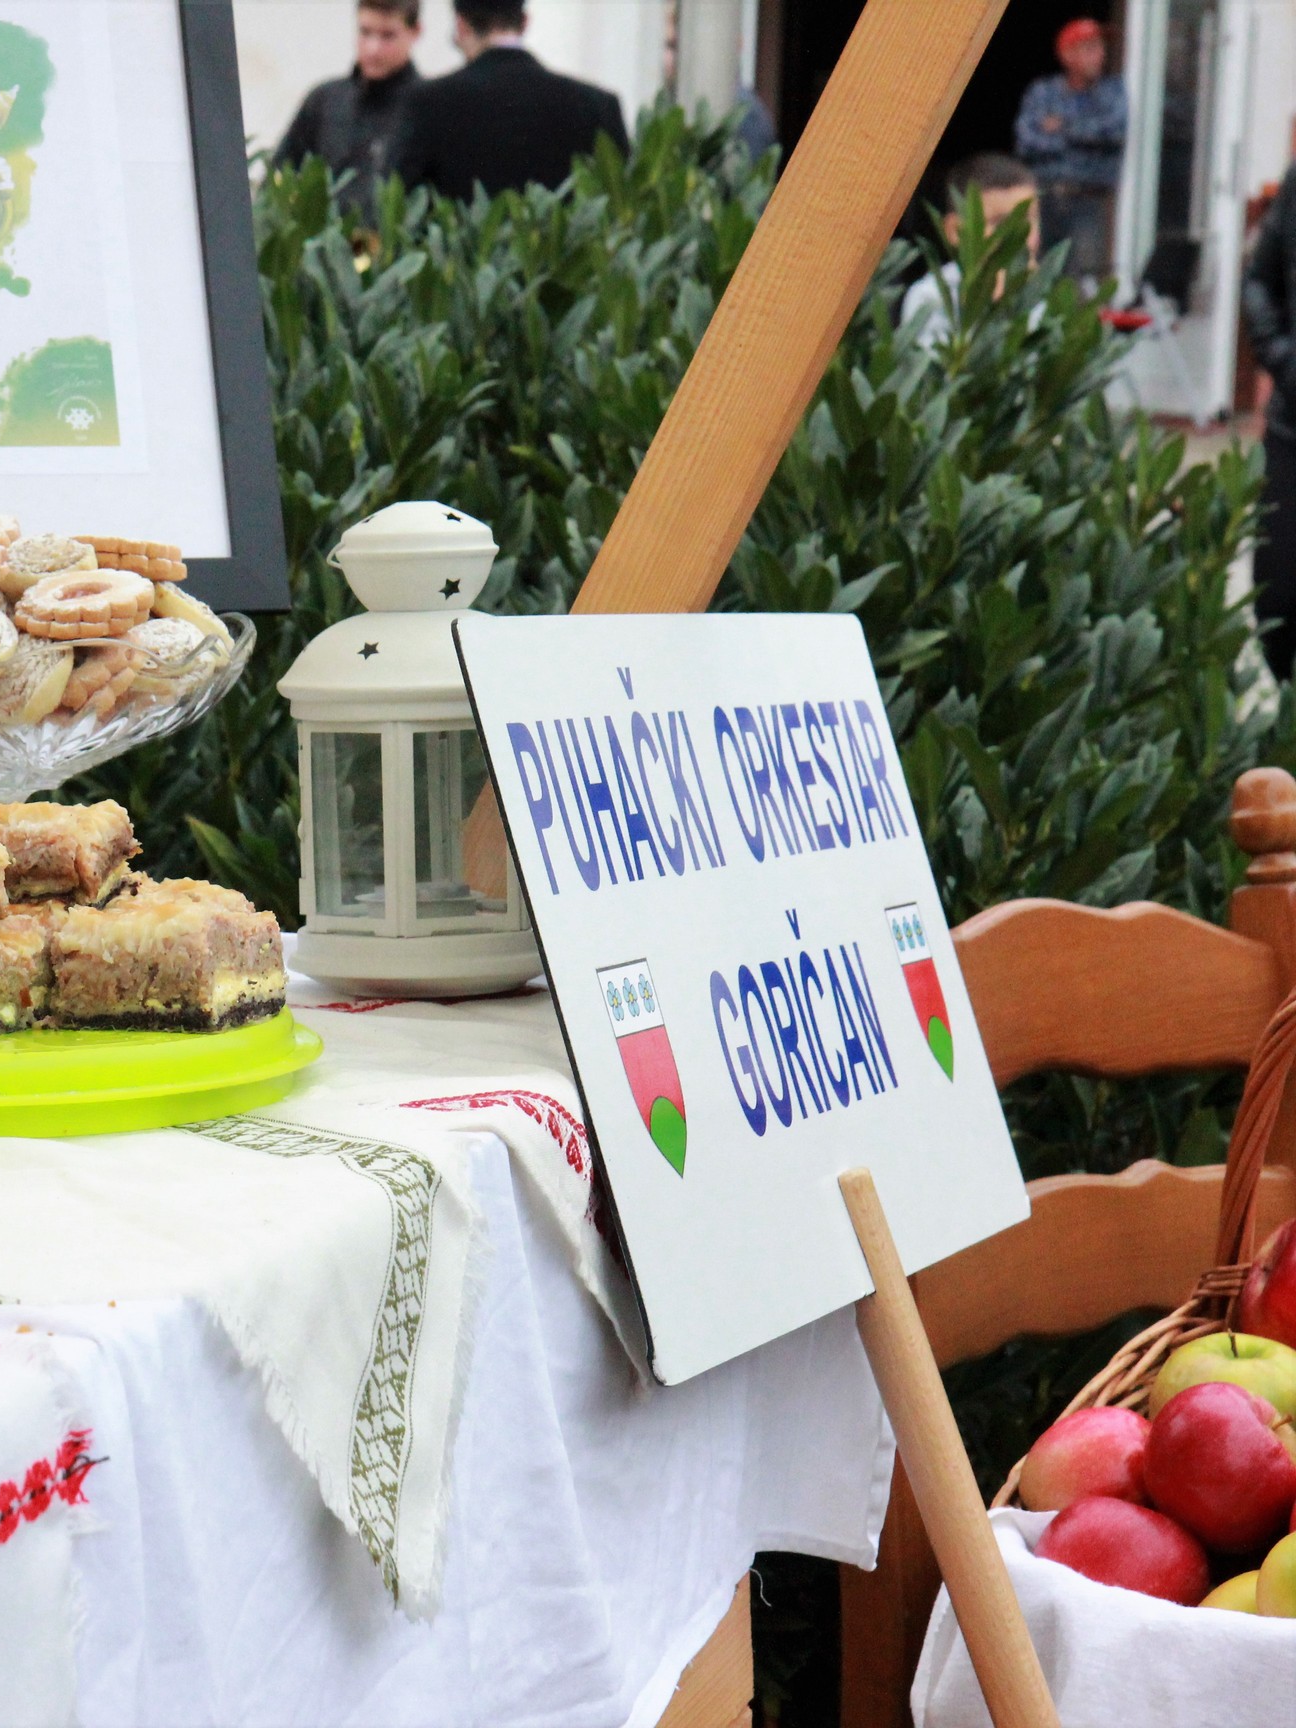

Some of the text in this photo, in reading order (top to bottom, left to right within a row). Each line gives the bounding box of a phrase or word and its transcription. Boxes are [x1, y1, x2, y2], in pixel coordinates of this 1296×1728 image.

[506, 667, 909, 896] PUHAČKI ORKESTAR
[709, 908, 899, 1138] GORIČAN
